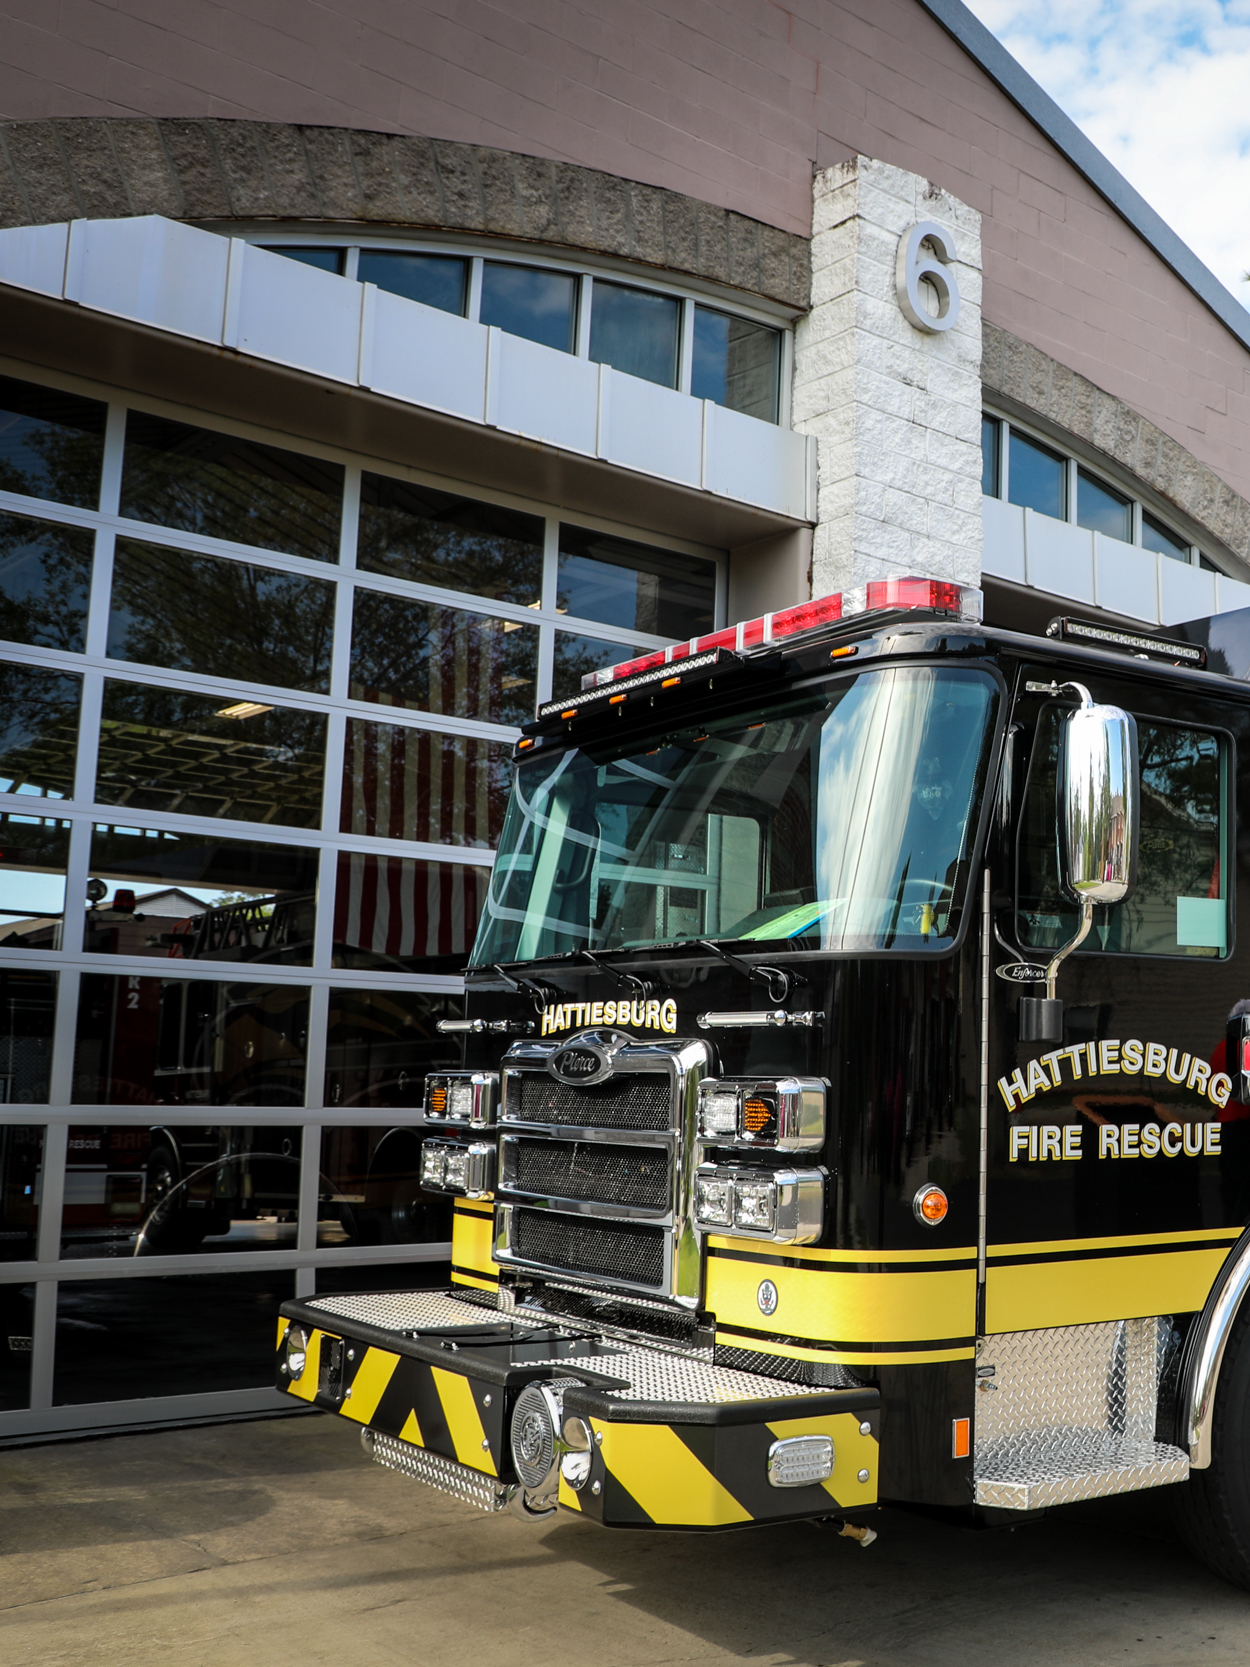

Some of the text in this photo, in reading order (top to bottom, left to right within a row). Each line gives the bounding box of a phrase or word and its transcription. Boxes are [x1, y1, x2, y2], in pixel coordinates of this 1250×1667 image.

[896, 220, 960, 335] 6
[541, 998, 677, 1037] HATTIESBURG
[560, 1050, 596, 1075] Pierce
[997, 1039, 1233, 1112] HATTIESBURG
[1009, 1122, 1222, 1162] FIRE RESCUE
